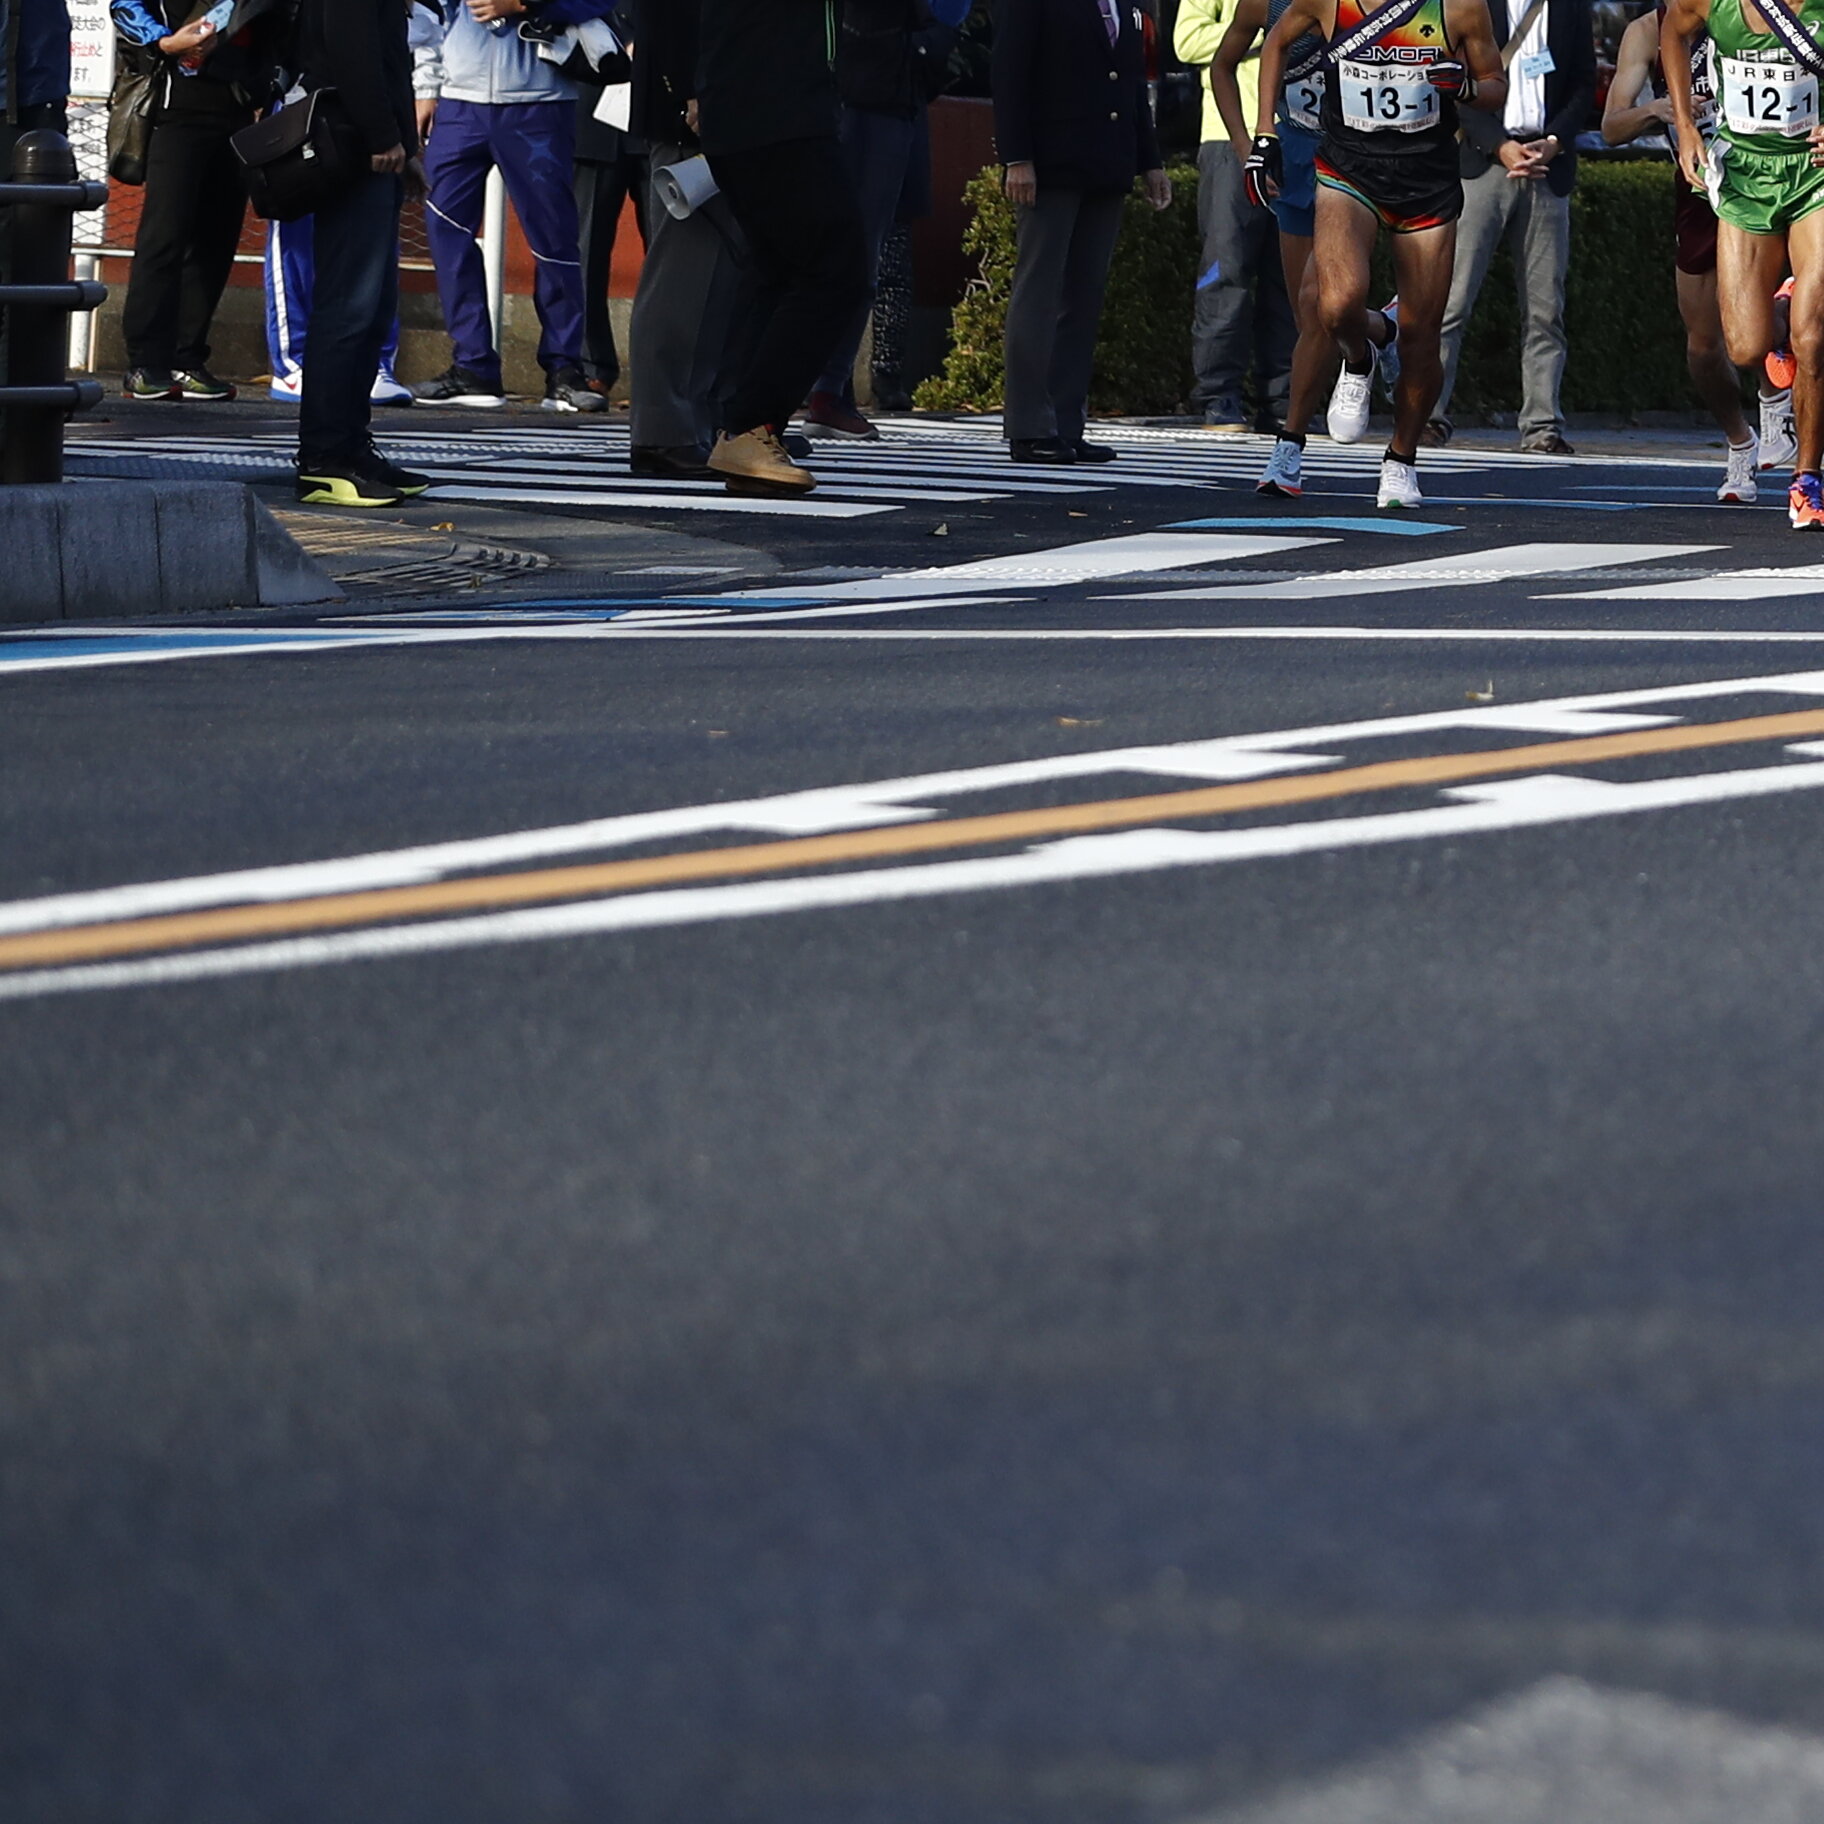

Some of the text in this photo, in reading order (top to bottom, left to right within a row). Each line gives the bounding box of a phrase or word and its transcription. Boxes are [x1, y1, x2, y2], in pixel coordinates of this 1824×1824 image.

[1301, 87, 1324, 116] 2
[1360, 86, 1434, 120] 13-1
[1741, 84, 1812, 121] 12-1
